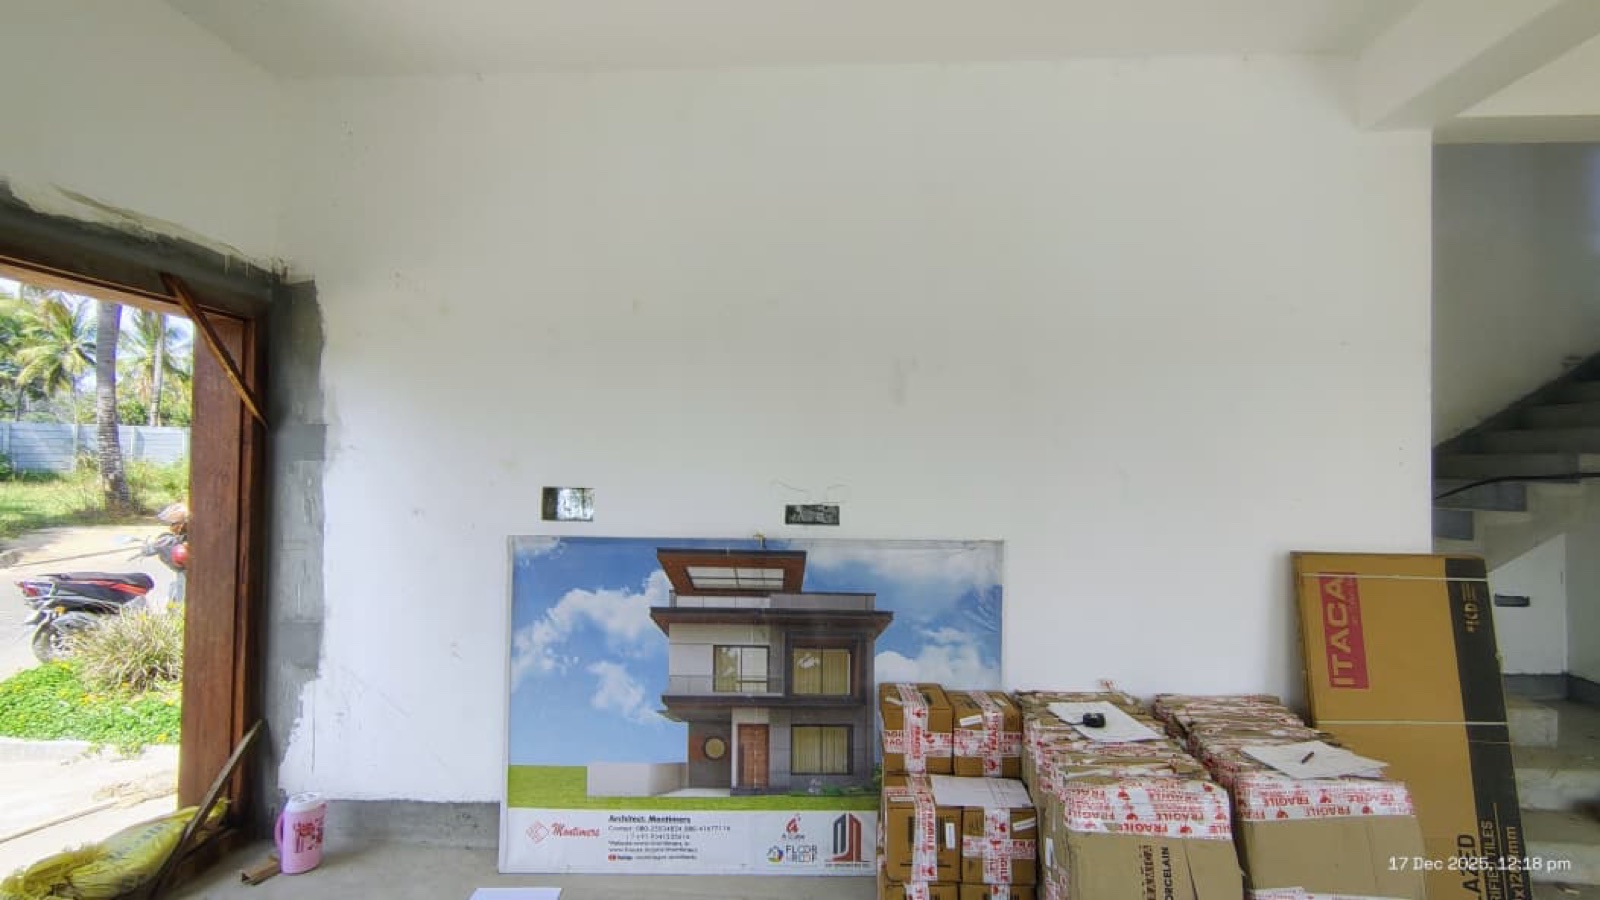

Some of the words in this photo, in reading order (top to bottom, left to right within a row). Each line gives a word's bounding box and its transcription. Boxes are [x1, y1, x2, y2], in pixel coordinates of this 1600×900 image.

[1325, 577, 1356, 687] ITACA
[1118, 823, 1169, 833] FRAGILE
[1155, 813, 1204, 821] FRAGILE
[1481, 820, 1497, 856] TILES
